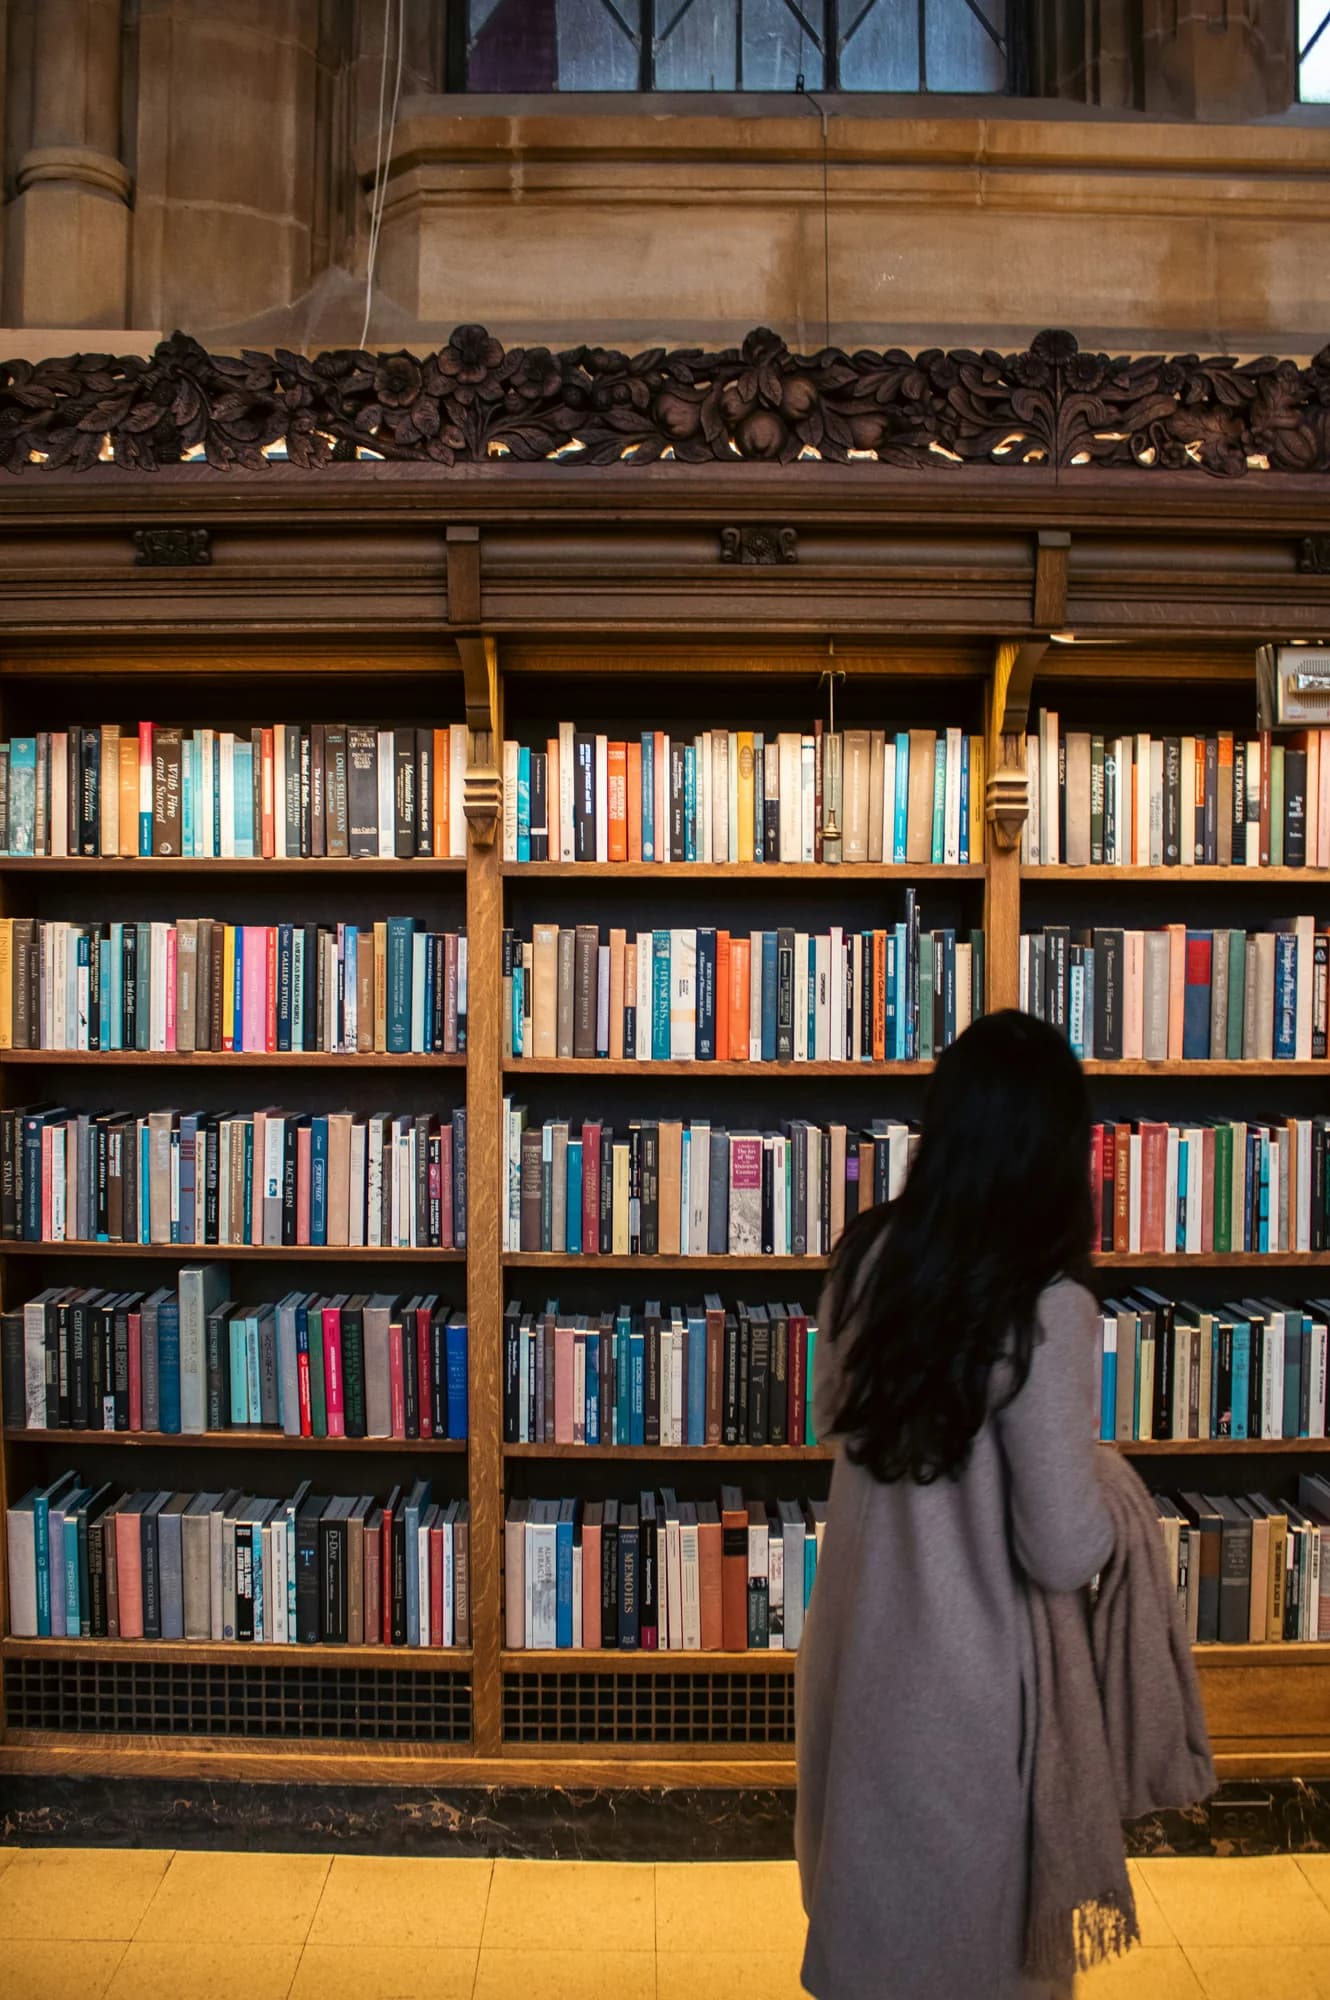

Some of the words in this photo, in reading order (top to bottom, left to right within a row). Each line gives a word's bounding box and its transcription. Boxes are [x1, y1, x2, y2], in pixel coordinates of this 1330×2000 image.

[156, 757, 167, 781] and
[167, 763, 178, 790] With
[335, 752, 345, 781] LOUIS
[405, 764, 413, 803] Mountain
[156, 785, 167, 824] Sword
[167, 794, 178, 818] Fire
[335, 784, 345, 832] SULLIVAN
[405, 804, 413, 822] Fires
[281, 951, 289, 984] GALILEO
[281, 987, 289, 1019] STUDIES
[581, 998, 589, 1029] JUSTICE
[3, 1160, 12, 1195] STALIN
[1118, 1149, 1126, 1192] APOLLO'S
[1118, 1195, 1126, 1217] FIRE
[74, 1310, 82, 1360] CHUTZPAH
[115, 1321, 127, 1350] DOUBLE
[752, 1327, 767, 1366] BULL!
[115, 1351, 127, 1392] DECEPTION
[329, 1530, 338, 1560] D-DAY
[457, 1553, 466, 1581] TWICE
[624, 1552, 634, 1613] MEMOIRS
[457, 1583, 466, 1620] BLESSED
